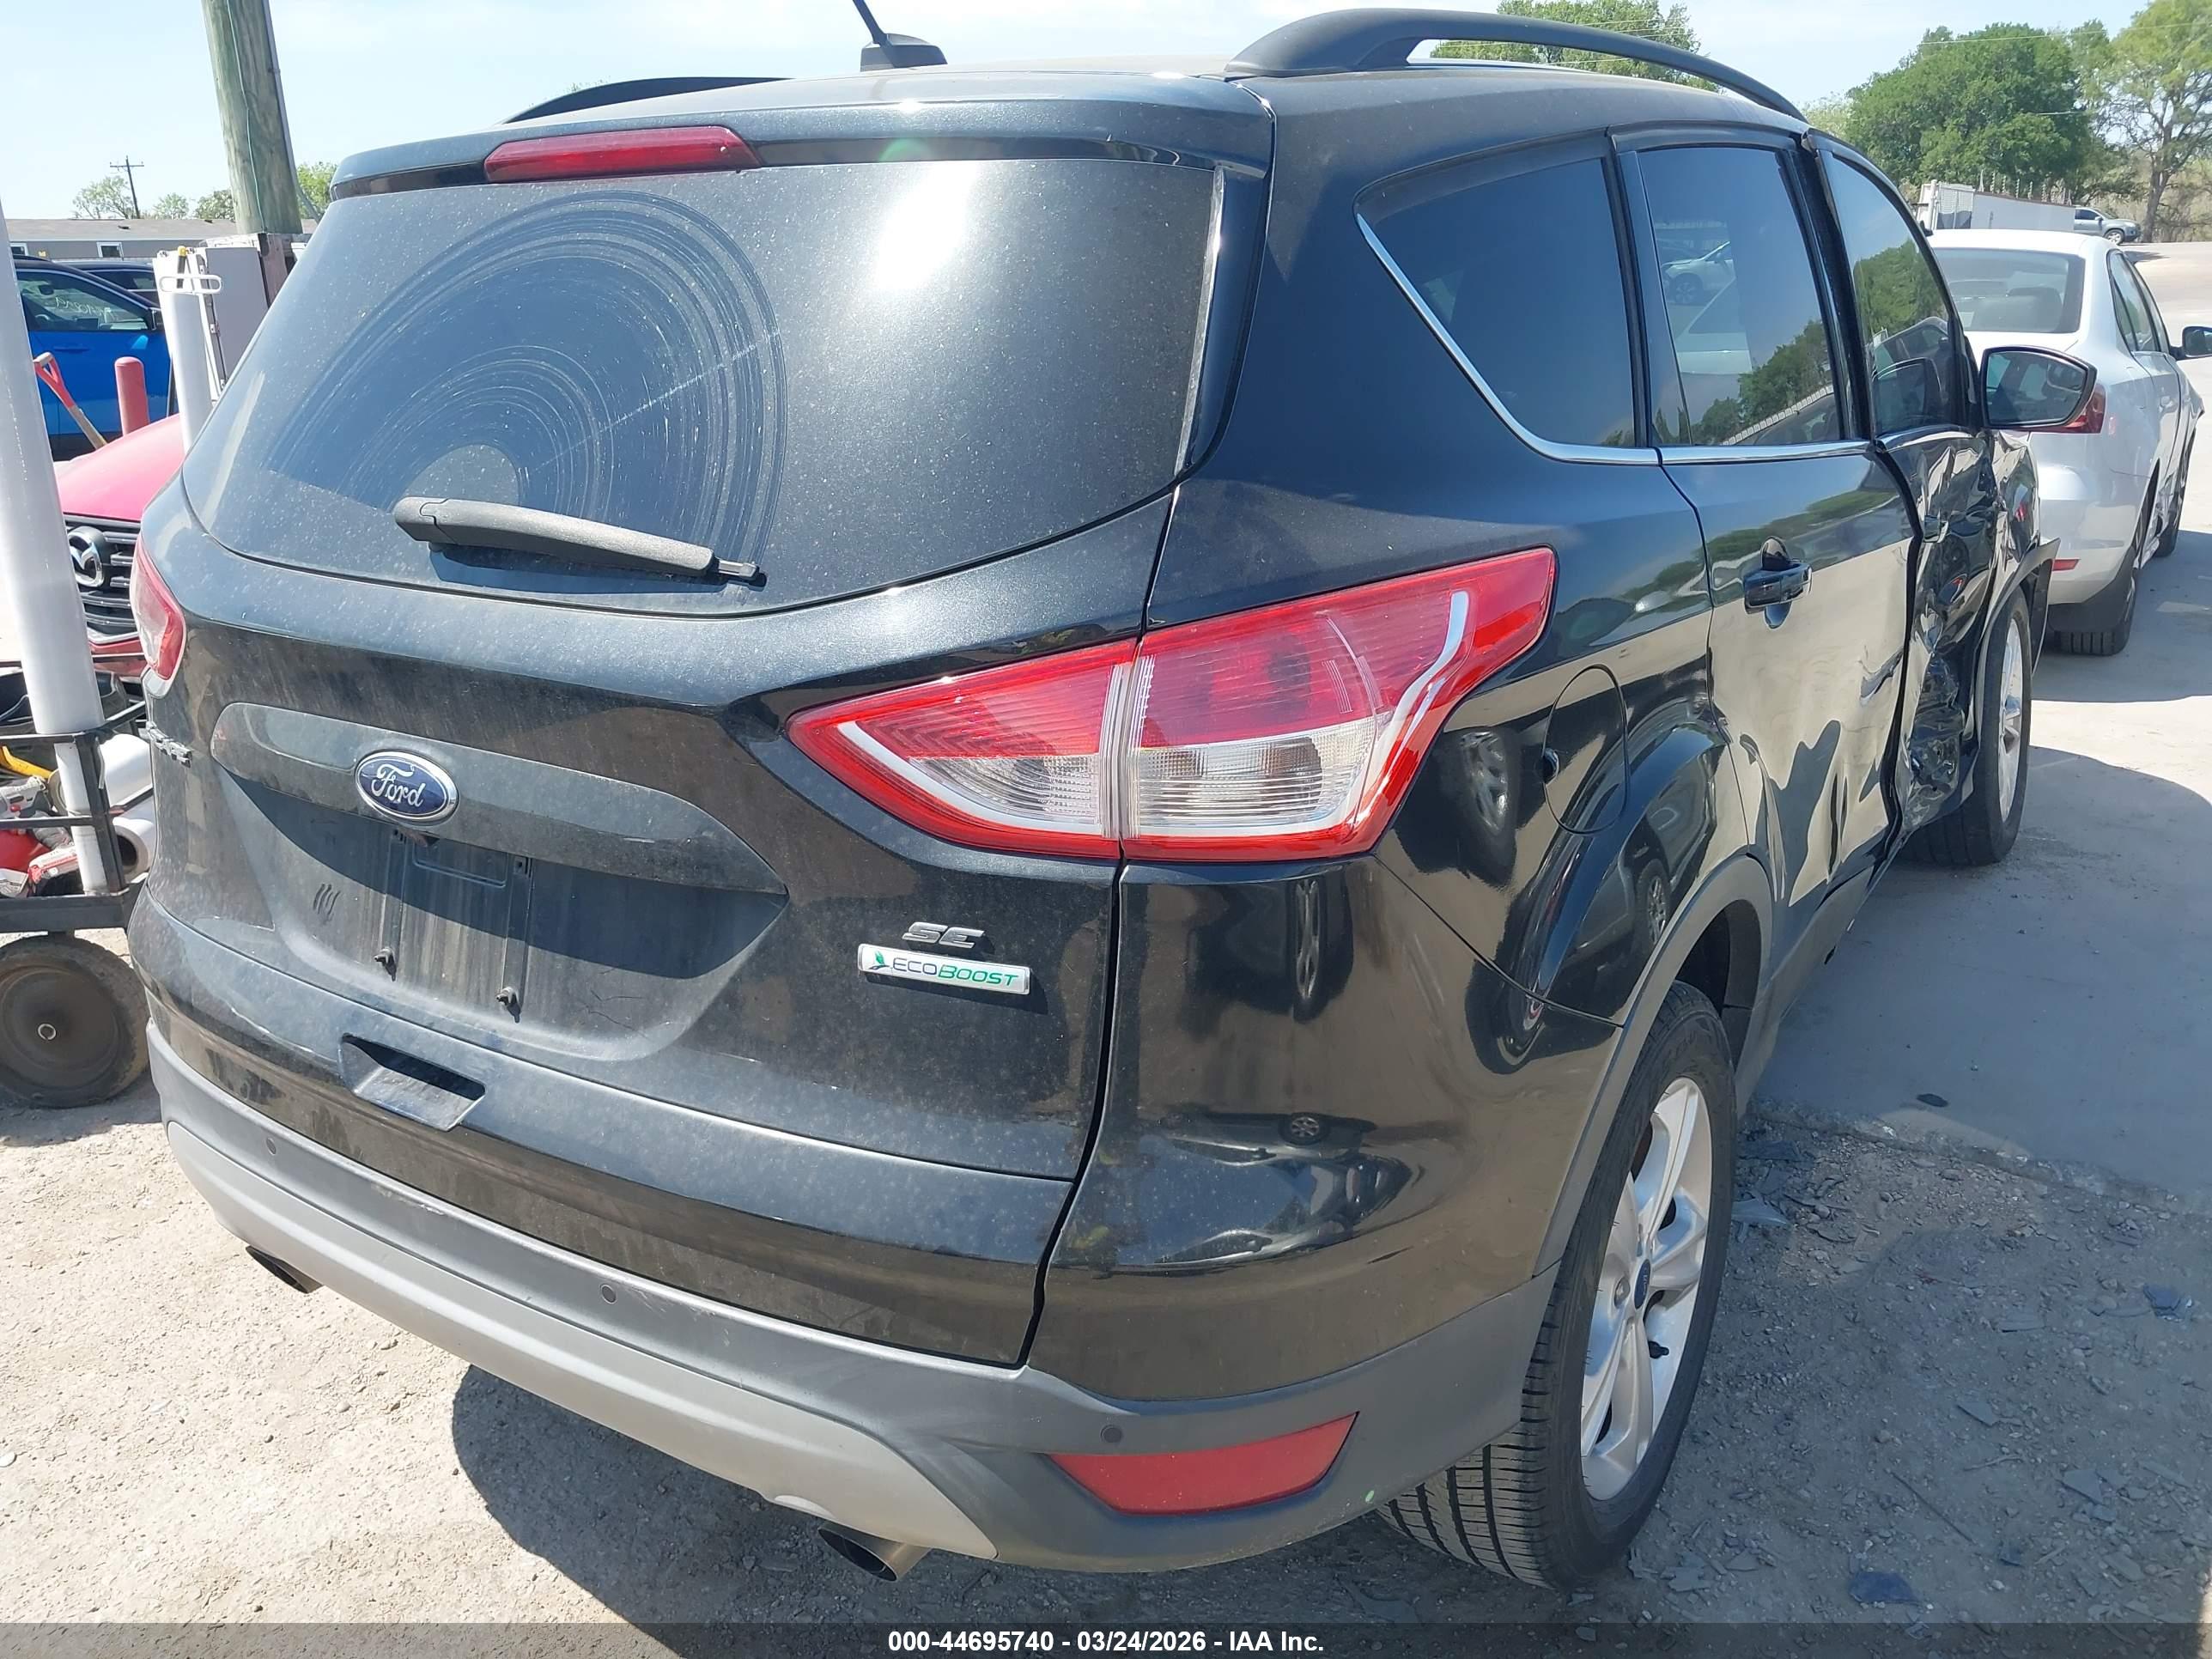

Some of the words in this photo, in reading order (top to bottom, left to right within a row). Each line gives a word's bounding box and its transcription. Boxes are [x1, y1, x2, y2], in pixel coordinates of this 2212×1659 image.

[371, 763, 427, 807] Ford
[902, 921, 985, 949] SE
[892, 957, 1019, 987] ECOBOOST
